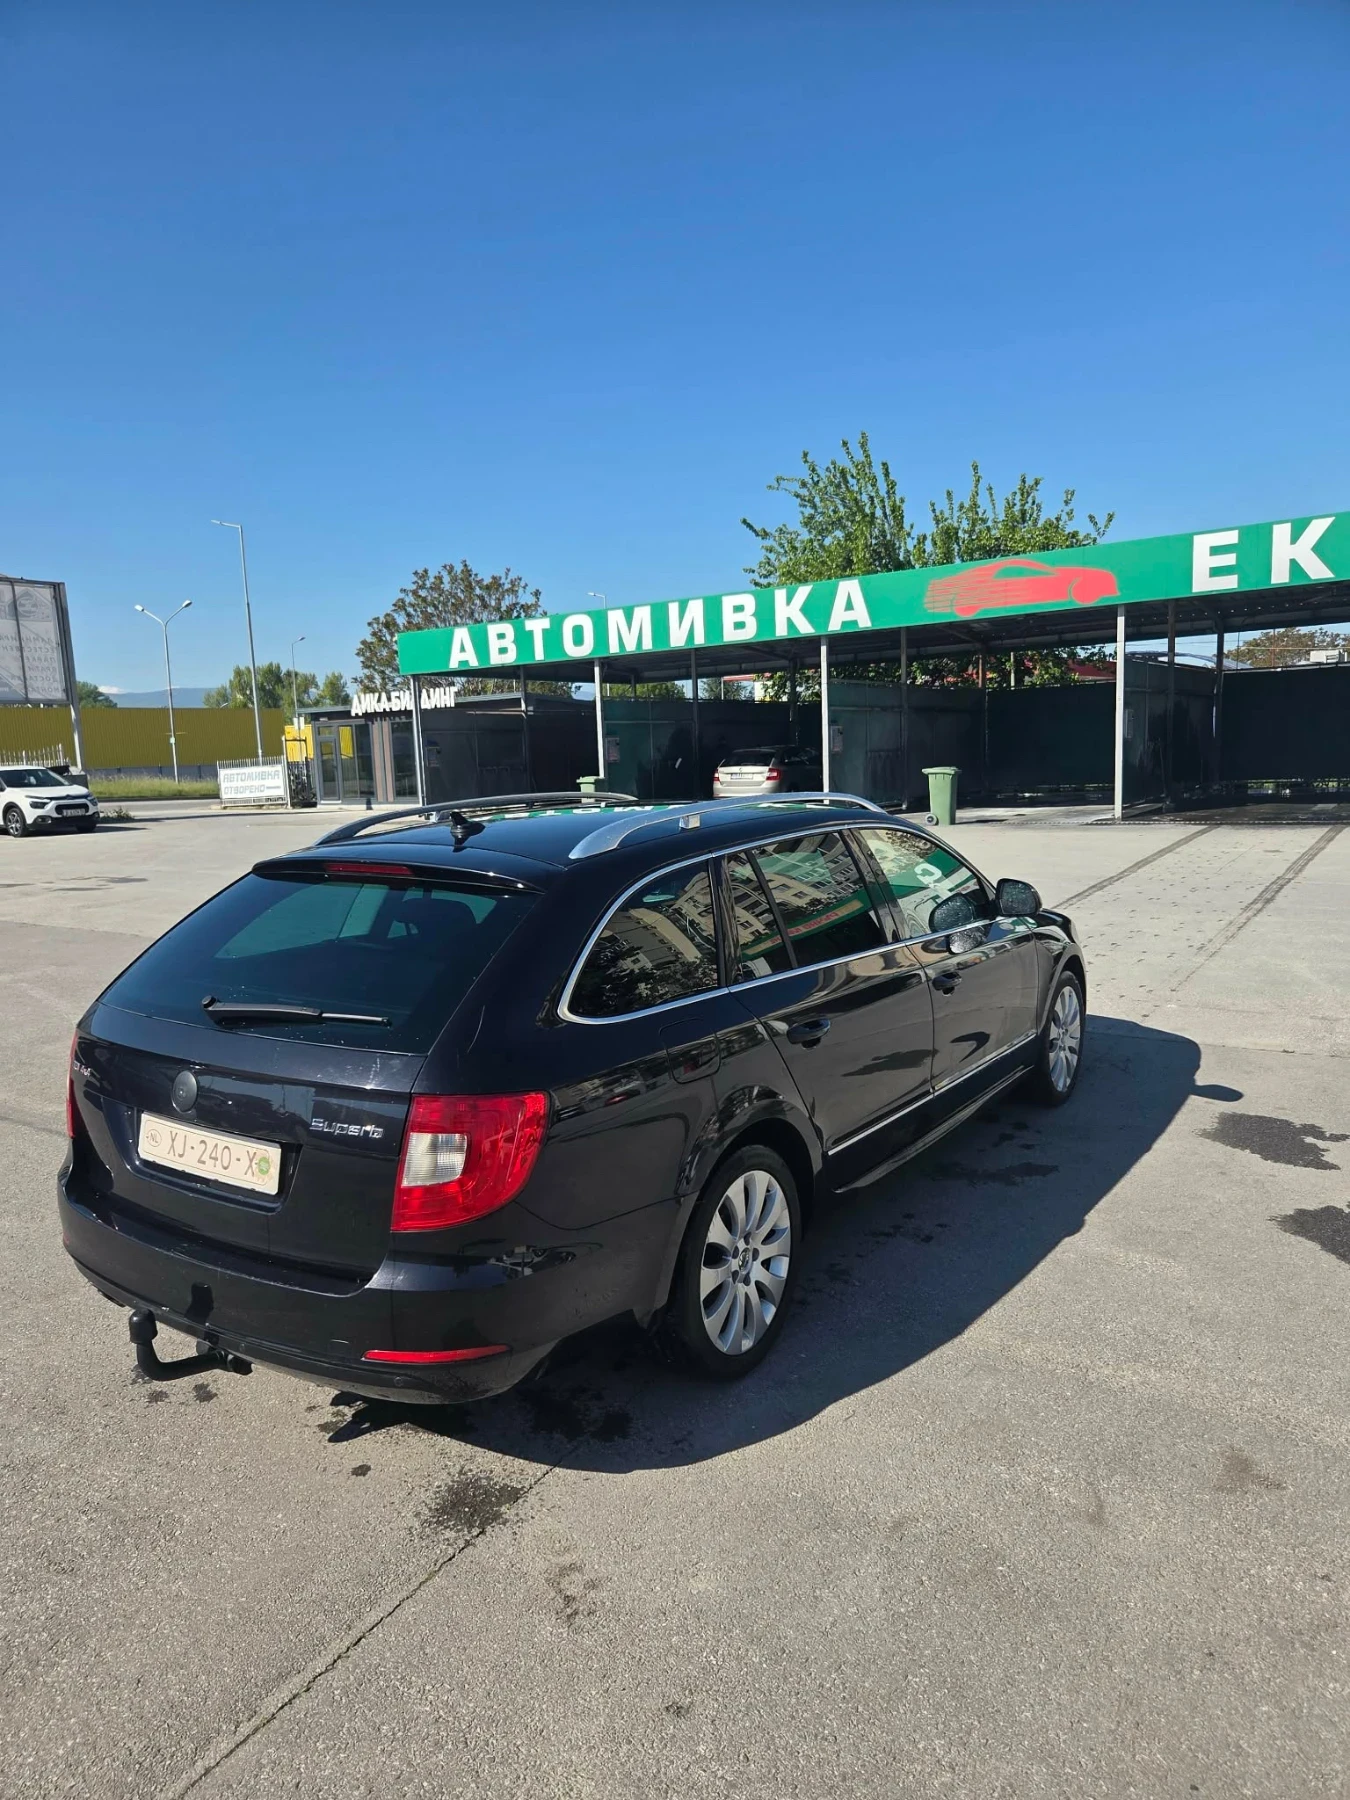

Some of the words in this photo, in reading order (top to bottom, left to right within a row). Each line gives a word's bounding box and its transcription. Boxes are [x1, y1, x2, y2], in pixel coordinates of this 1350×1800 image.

[449, 578, 872, 669] АВТОМИВКА
[223, 769, 280, 783] АВТОМИВКА
[224, 784, 265, 795] ОТВОРЕНО
[309, 1118, 385, 1139] Superb
[167, 1130, 257, 1177] XJ-240-X
